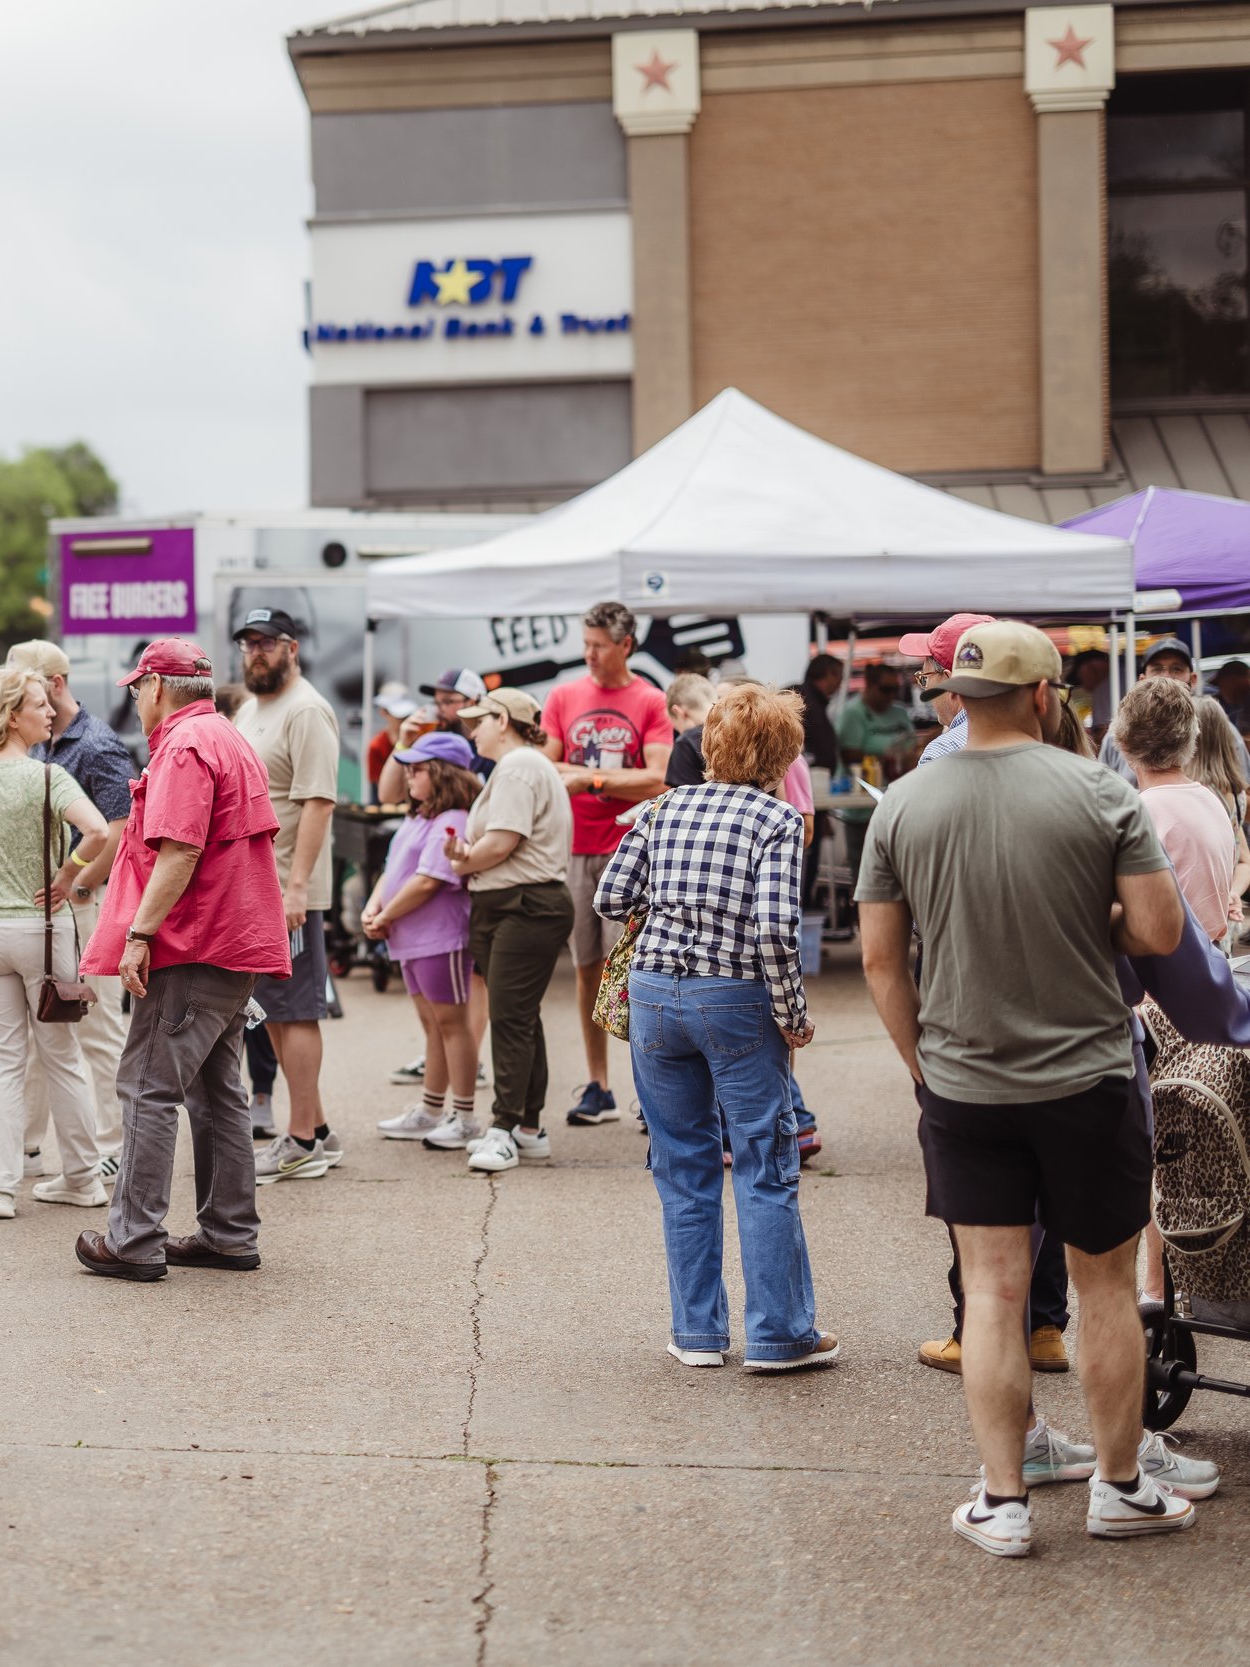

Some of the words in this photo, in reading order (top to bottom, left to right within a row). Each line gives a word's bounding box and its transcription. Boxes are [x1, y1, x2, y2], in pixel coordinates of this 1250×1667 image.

[316, 318, 435, 342] National
[445, 318, 513, 341] Bank
[529, 314, 544, 336] &
[559, 313, 631, 337] Trust
[69, 583, 109, 619] FREE
[110, 580, 188, 618] BURGERS
[491, 616, 568, 656] FEED
[571, 720, 633, 750] Green
[1006, 1512, 1022, 1520] NIKE
